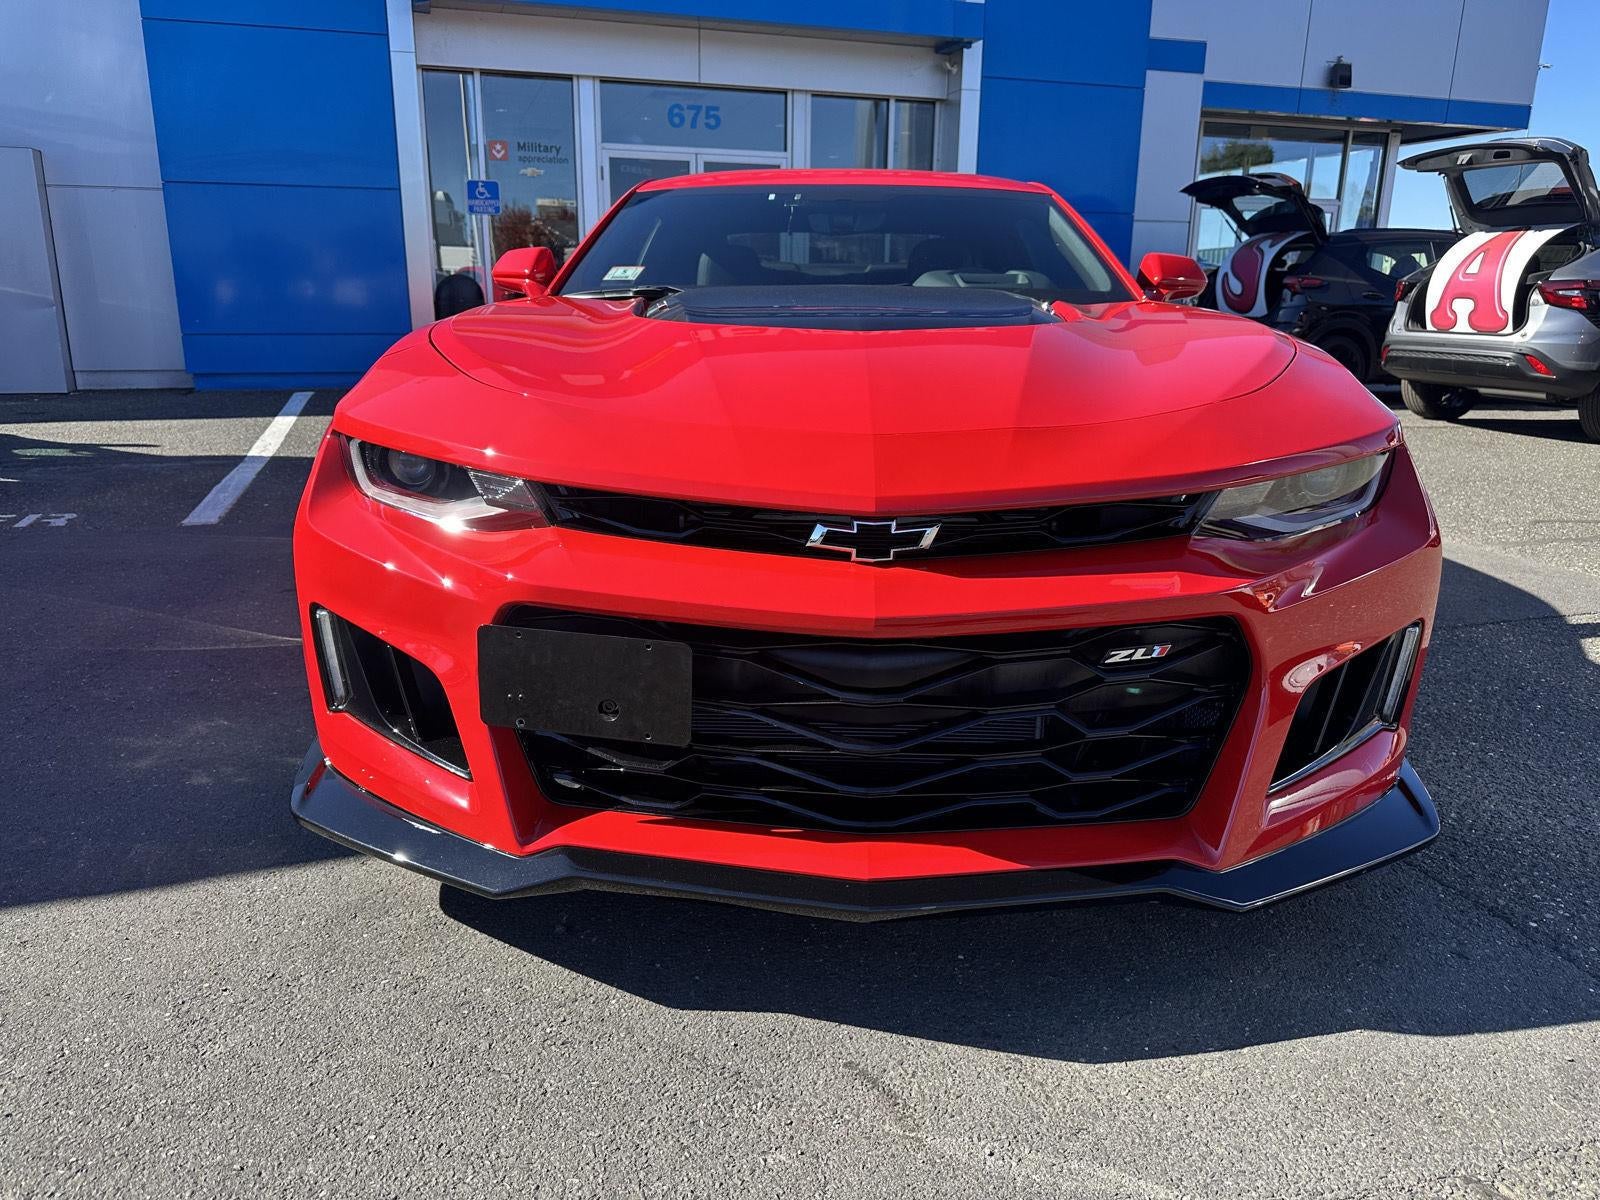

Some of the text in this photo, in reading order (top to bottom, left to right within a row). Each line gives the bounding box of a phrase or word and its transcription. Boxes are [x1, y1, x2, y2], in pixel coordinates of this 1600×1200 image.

[667, 103, 722, 130] 675
[516, 141, 562, 156] Military
[518, 155, 569, 165] appreciation
[1430, 229, 1529, 333] A
[1104, 644, 1172, 664] ZL1
